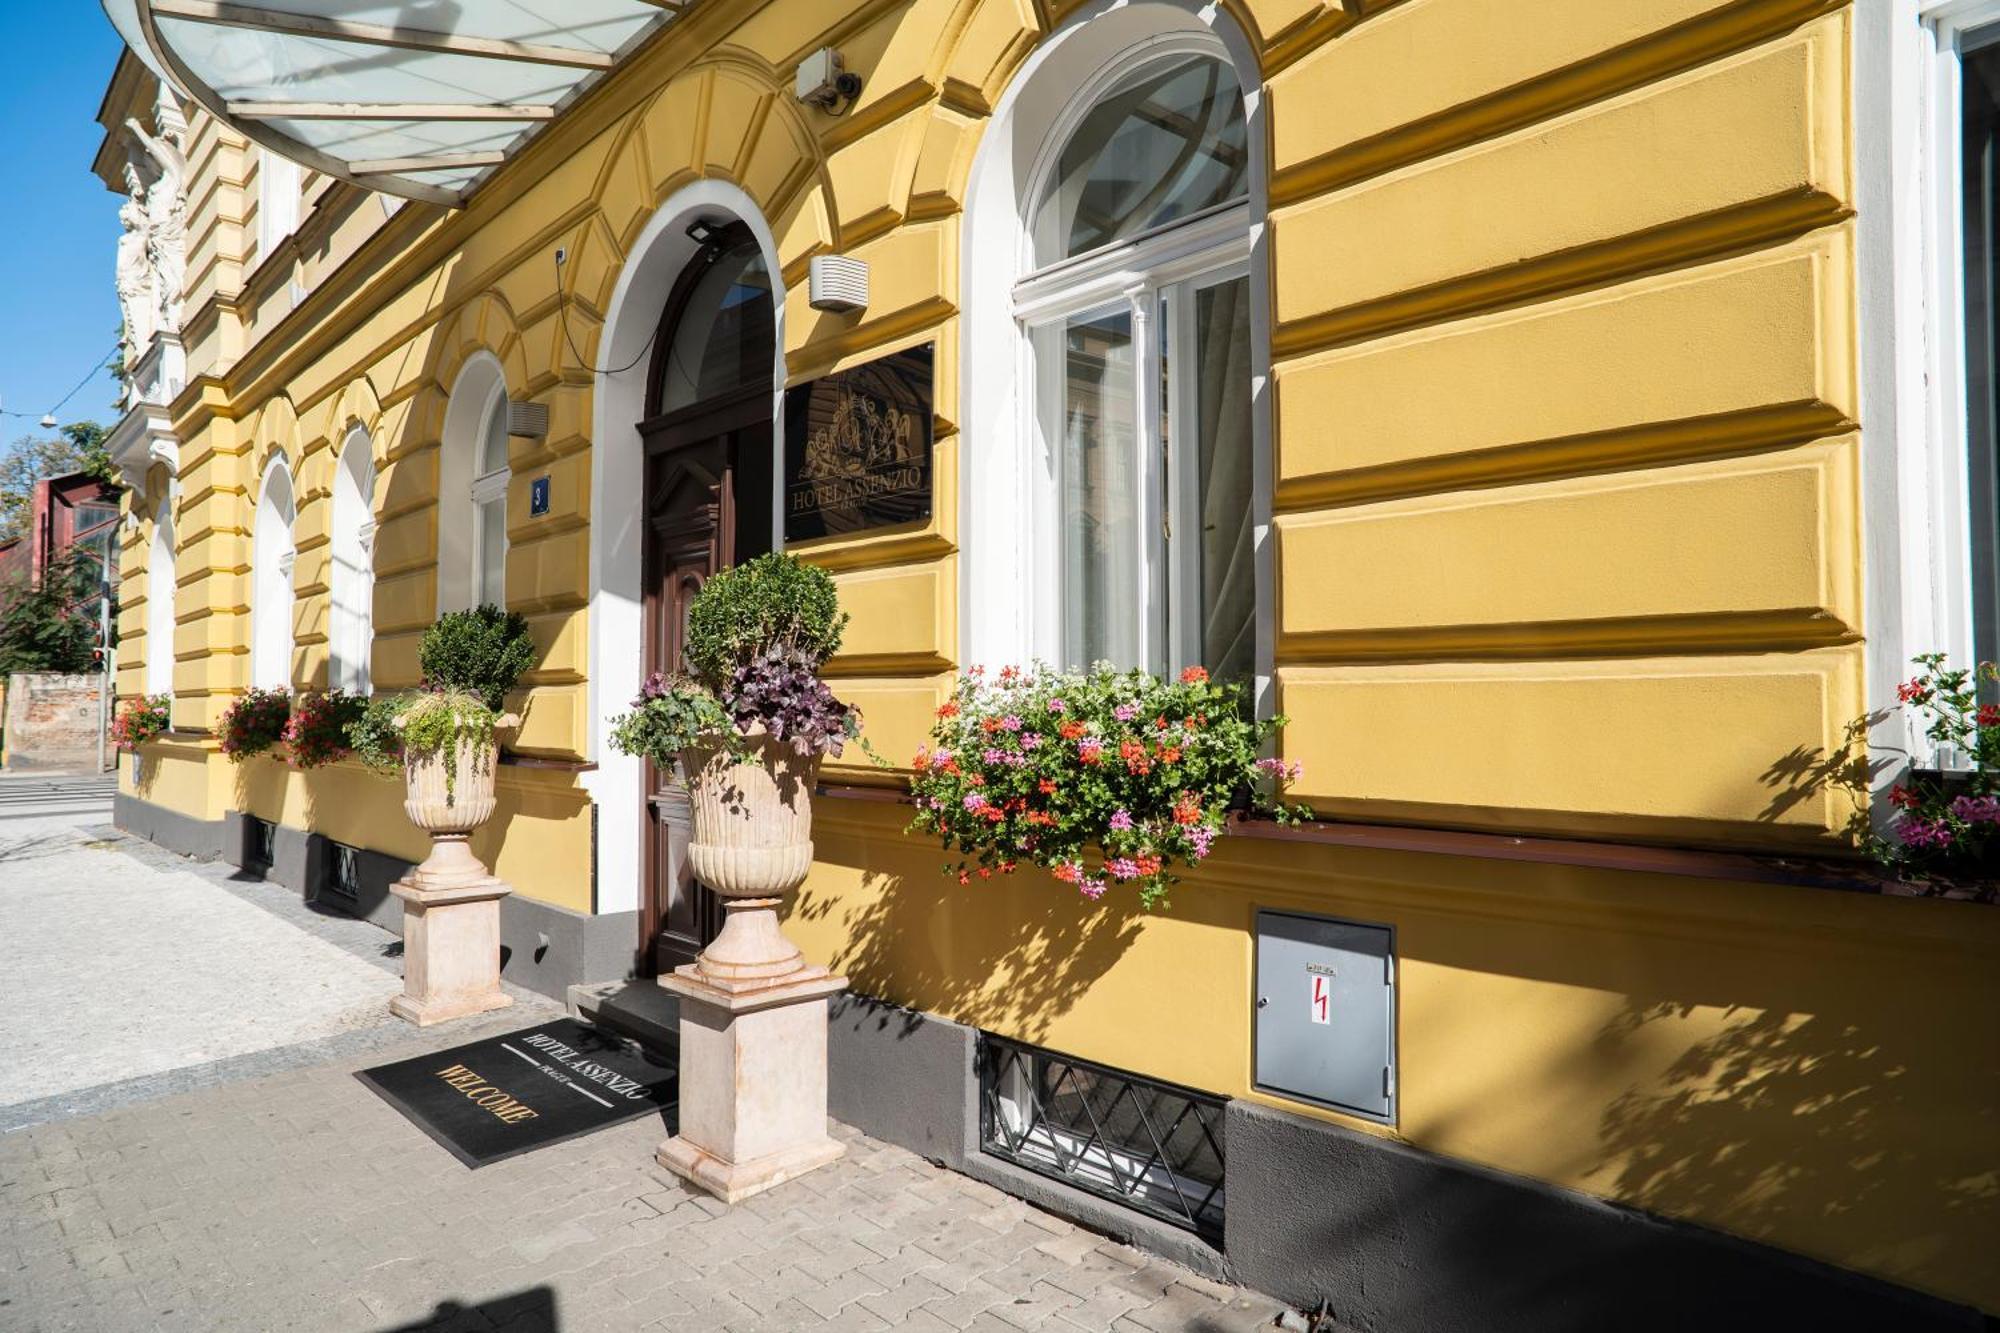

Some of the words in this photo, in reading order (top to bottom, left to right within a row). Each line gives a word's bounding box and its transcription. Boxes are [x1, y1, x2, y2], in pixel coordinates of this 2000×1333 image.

[793, 484, 842, 510] HOTEL
[845, 466, 921, 499] ASSENZIO
[434, 1064, 539, 1124] WELCOME
[522, 1033, 580, 1063] HOTEL
[566, 1060, 652, 1099] ASSENZIO
